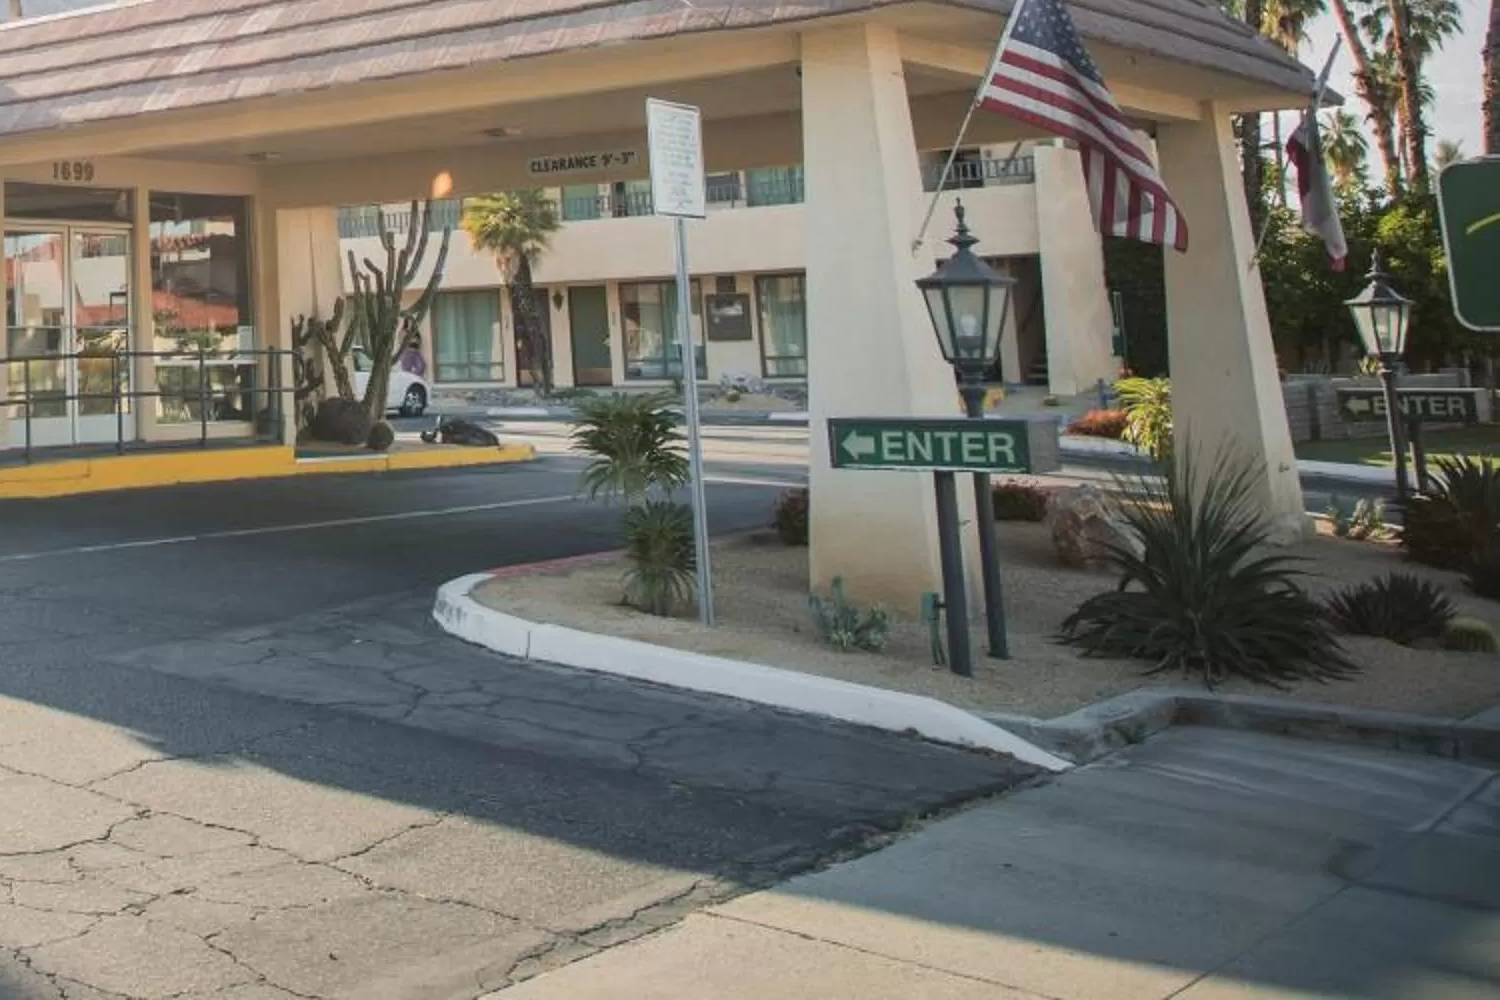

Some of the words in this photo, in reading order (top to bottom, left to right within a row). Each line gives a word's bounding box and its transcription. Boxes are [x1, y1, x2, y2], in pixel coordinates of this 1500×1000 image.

[52, 161, 95, 181] 1699
[531, 155, 597, 173] CLEARANCE
[880, 431, 1016, 464] ENTER
